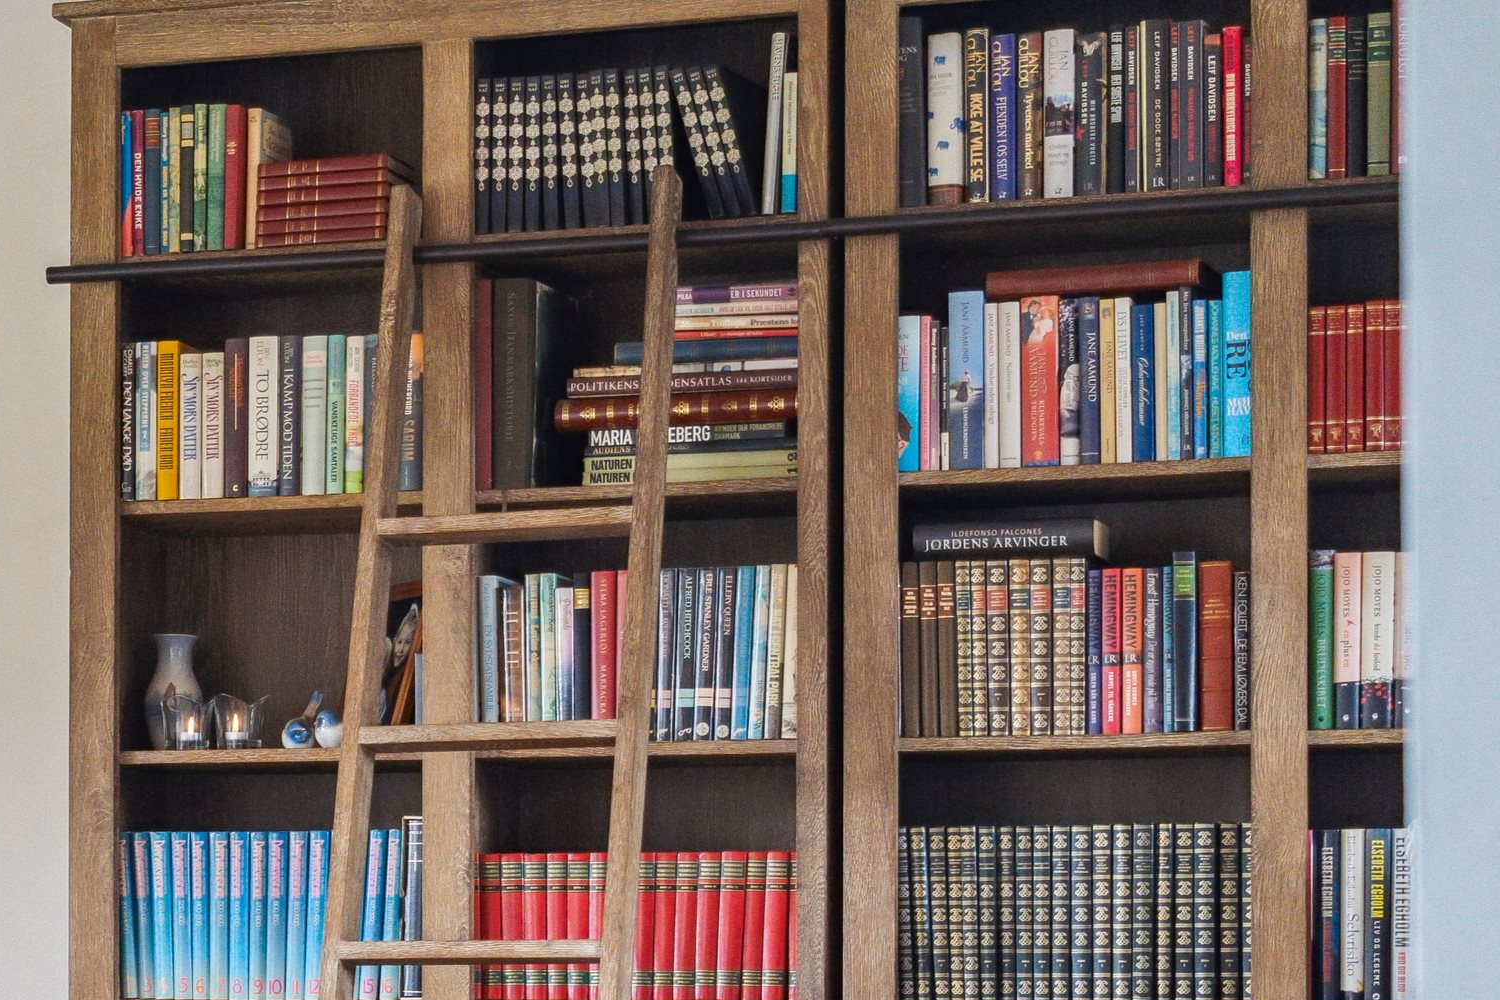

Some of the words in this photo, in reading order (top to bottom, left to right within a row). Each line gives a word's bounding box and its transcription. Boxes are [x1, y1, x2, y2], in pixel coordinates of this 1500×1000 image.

[976, 52, 986, 73] JAN
[1001, 55, 1012, 77] JAN
[1018, 38, 1029, 88] GUILLOU
[1029, 52, 1039, 74] JAN
[1060, 50, 1068, 71] JAN
[1207, 55, 1215, 75] LEIF
[970, 93, 983, 118] IKKE
[1023, 93, 1034, 131] Tyvenes
[1155, 99, 1161, 109] DE
[970, 119, 983, 134] AT
[995, 96, 1007, 137] FJENDEN
[134, 153, 142, 172] DEN
[970, 136, 983, 167] VILLE
[997, 145, 1007, 157] OS
[1025, 133, 1034, 169] marked
[970, 169, 983, 182] SE
[997, 158, 1007, 180] SELV
[134, 174, 142, 202] HVIDE
[1153, 177, 1165, 187] LR
[730, 290, 739, 298] ER
[746, 288, 782, 297] SEKUNDET
[960, 302, 969, 322] JANE
[1117, 311, 1127, 327] LYS
[1086, 332, 1096, 356] JANE
[1117, 335, 1127, 361] LIVET
[256, 369, 269, 392] TO
[570, 381, 639, 392] POLITIKENS
[750, 375, 792, 383] KORTSIDER
[1029, 347, 1038, 397] AAMUND
[1088, 358, 1096, 402] AAMUND
[122, 381, 133, 406] DEN
[284, 374, 293, 409] KAMP
[122, 408, 132, 443] LANGE
[255, 396, 269, 460] BRØDRE
[283, 411, 293, 441] MOD
[183, 426, 197, 461] DATTER
[206, 425, 220, 461] DATTER
[590, 430, 632, 446] MARIA
[122, 446, 132, 472] DØD
[283, 443, 293, 480] TIDEN
[591, 459, 632, 470] NATUREN
[589, 472, 630, 483] NATUREN
[924, 538, 989, 552] JORDENS
[994, 536, 1068, 549] ARVINGER
[951, 529, 998, 537] ILDEFONSO
[1000, 528, 1042, 536] FALCONES
[1147, 573, 1158, 597] Ernest
[1238, 576, 1247, 596] KEN
[1373, 565, 1381, 585] JOJO
[1104, 575, 1116, 649] HEMINGWAY
[1125, 575, 1137, 649] HEMINGWAY
[1373, 589, 1381, 617] MOYES
[1144, 598, 1158, 638] Hemingway
[1238, 600, 1247, 632] FOLLETT
[484, 625, 492, 636] EN
[683, 609, 692, 659] HITCHCOCK
[701, 633, 710, 671] GARDNER
[1238, 638, 1247, 649] DE
[1340, 640, 1352, 658] plus
[1104, 655, 1116, 663] LR
[1126, 654, 1137, 663] LR
[1238, 652, 1247, 671] FEM
[1316, 639, 1327, 709] BRUDESKIBET
[769, 681, 779, 707] PARK
[1237, 674, 1248, 706] LØVERS
[1237, 708, 1247, 724] DAL
[1322, 847, 1333, 884] ELSEBETH
[1371, 840, 1384, 880] ELSEBETH
[1395, 837, 1411, 894] ELSEBETH
[1322, 886, 1333, 917] EGHOLM
[1371, 884, 1384, 918] EGHOLM
[1395, 900, 1410, 947] EGHOLM
[1346, 913, 1359, 976] Selvrisiko
[1374, 938, 1380, 949] OG
[179, 978, 188, 993] 5
[196, 979, 205, 993] 6
[232, 979, 242, 994] 8
[254, 980, 263, 994] 9
[269, 979, 282, 994] 10
[362, 979, 374, 994] 15
[381, 978, 393, 993] 16
